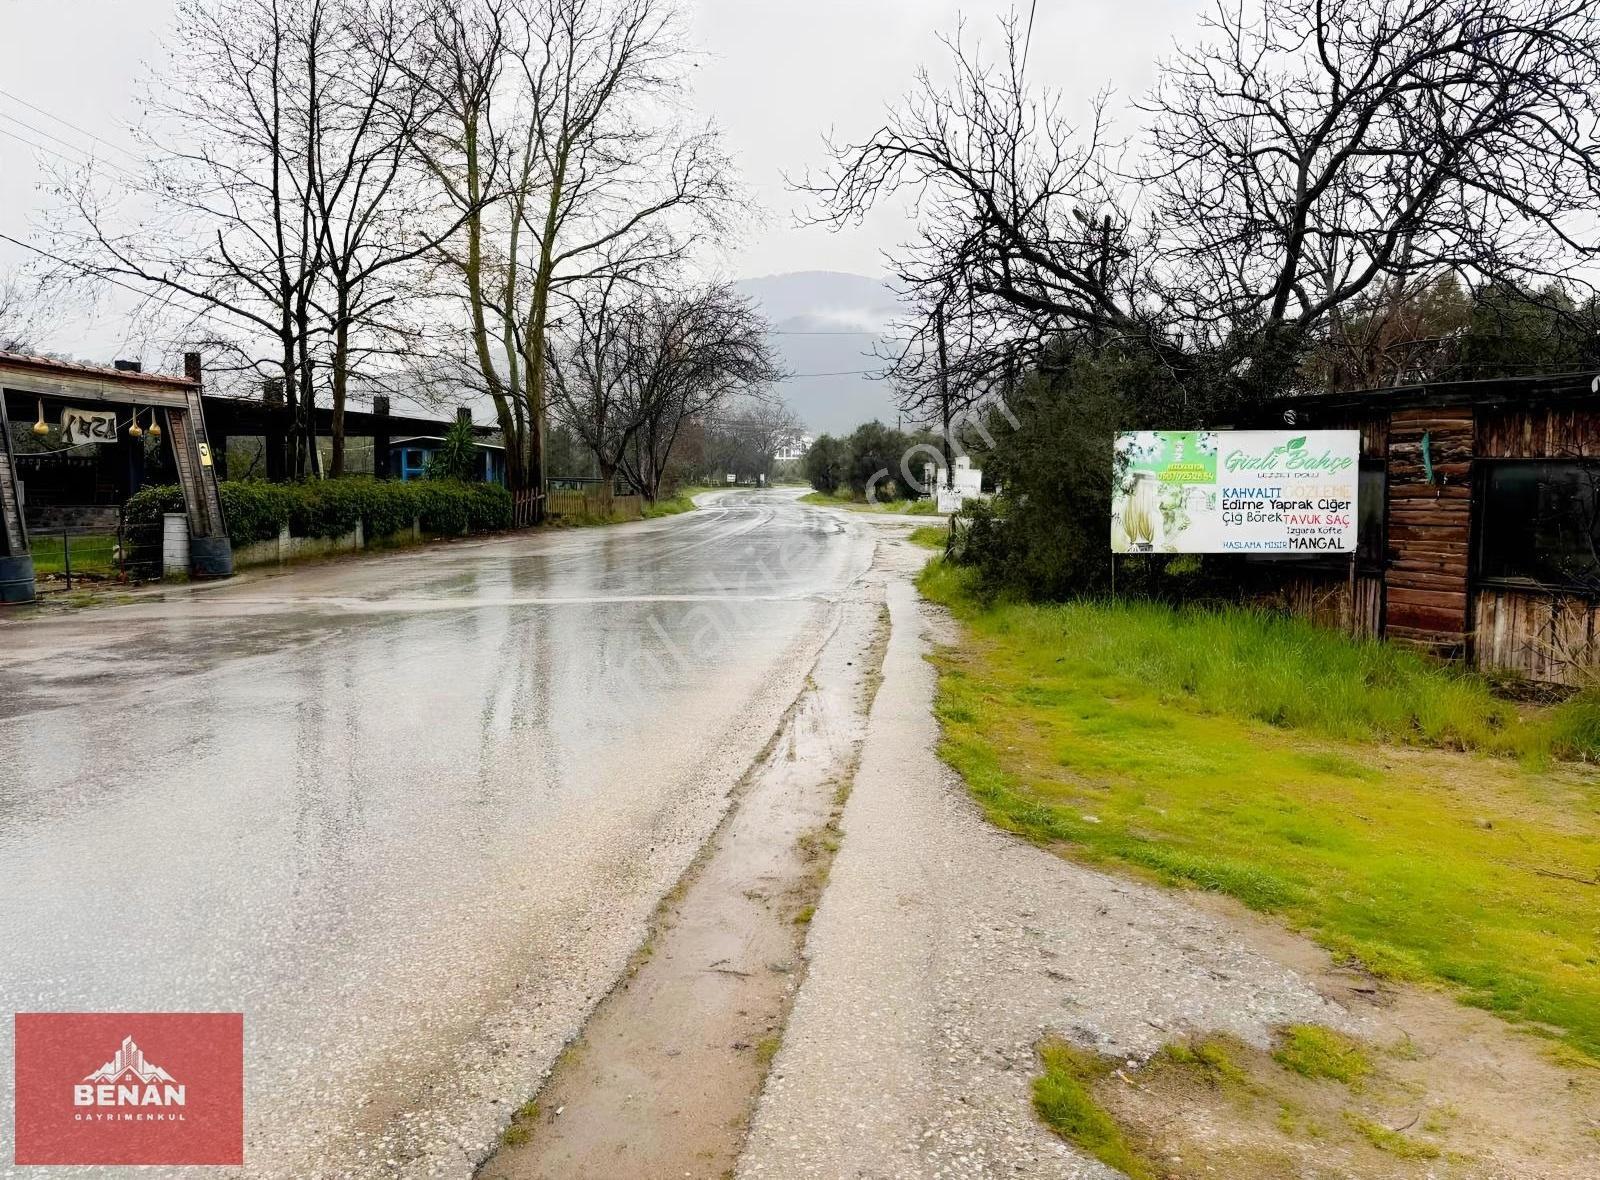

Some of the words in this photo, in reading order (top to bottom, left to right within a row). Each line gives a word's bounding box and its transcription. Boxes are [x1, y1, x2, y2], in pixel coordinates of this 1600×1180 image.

[1225, 449, 1279, 473] Gizli
[1285, 449, 1353, 475] Bahçe
[1222, 487, 1282, 499] KAHVALTI
[1222, 499, 1265, 510] Edirne
[1269, 499, 1314, 513] Yaprak
[1246, 510, 1283, 523] Börek
[1283, 514, 1322, 525] TAVUK
[1325, 514, 1350, 529] SAÇ
[1289, 537, 1345, 550] MANGAL
